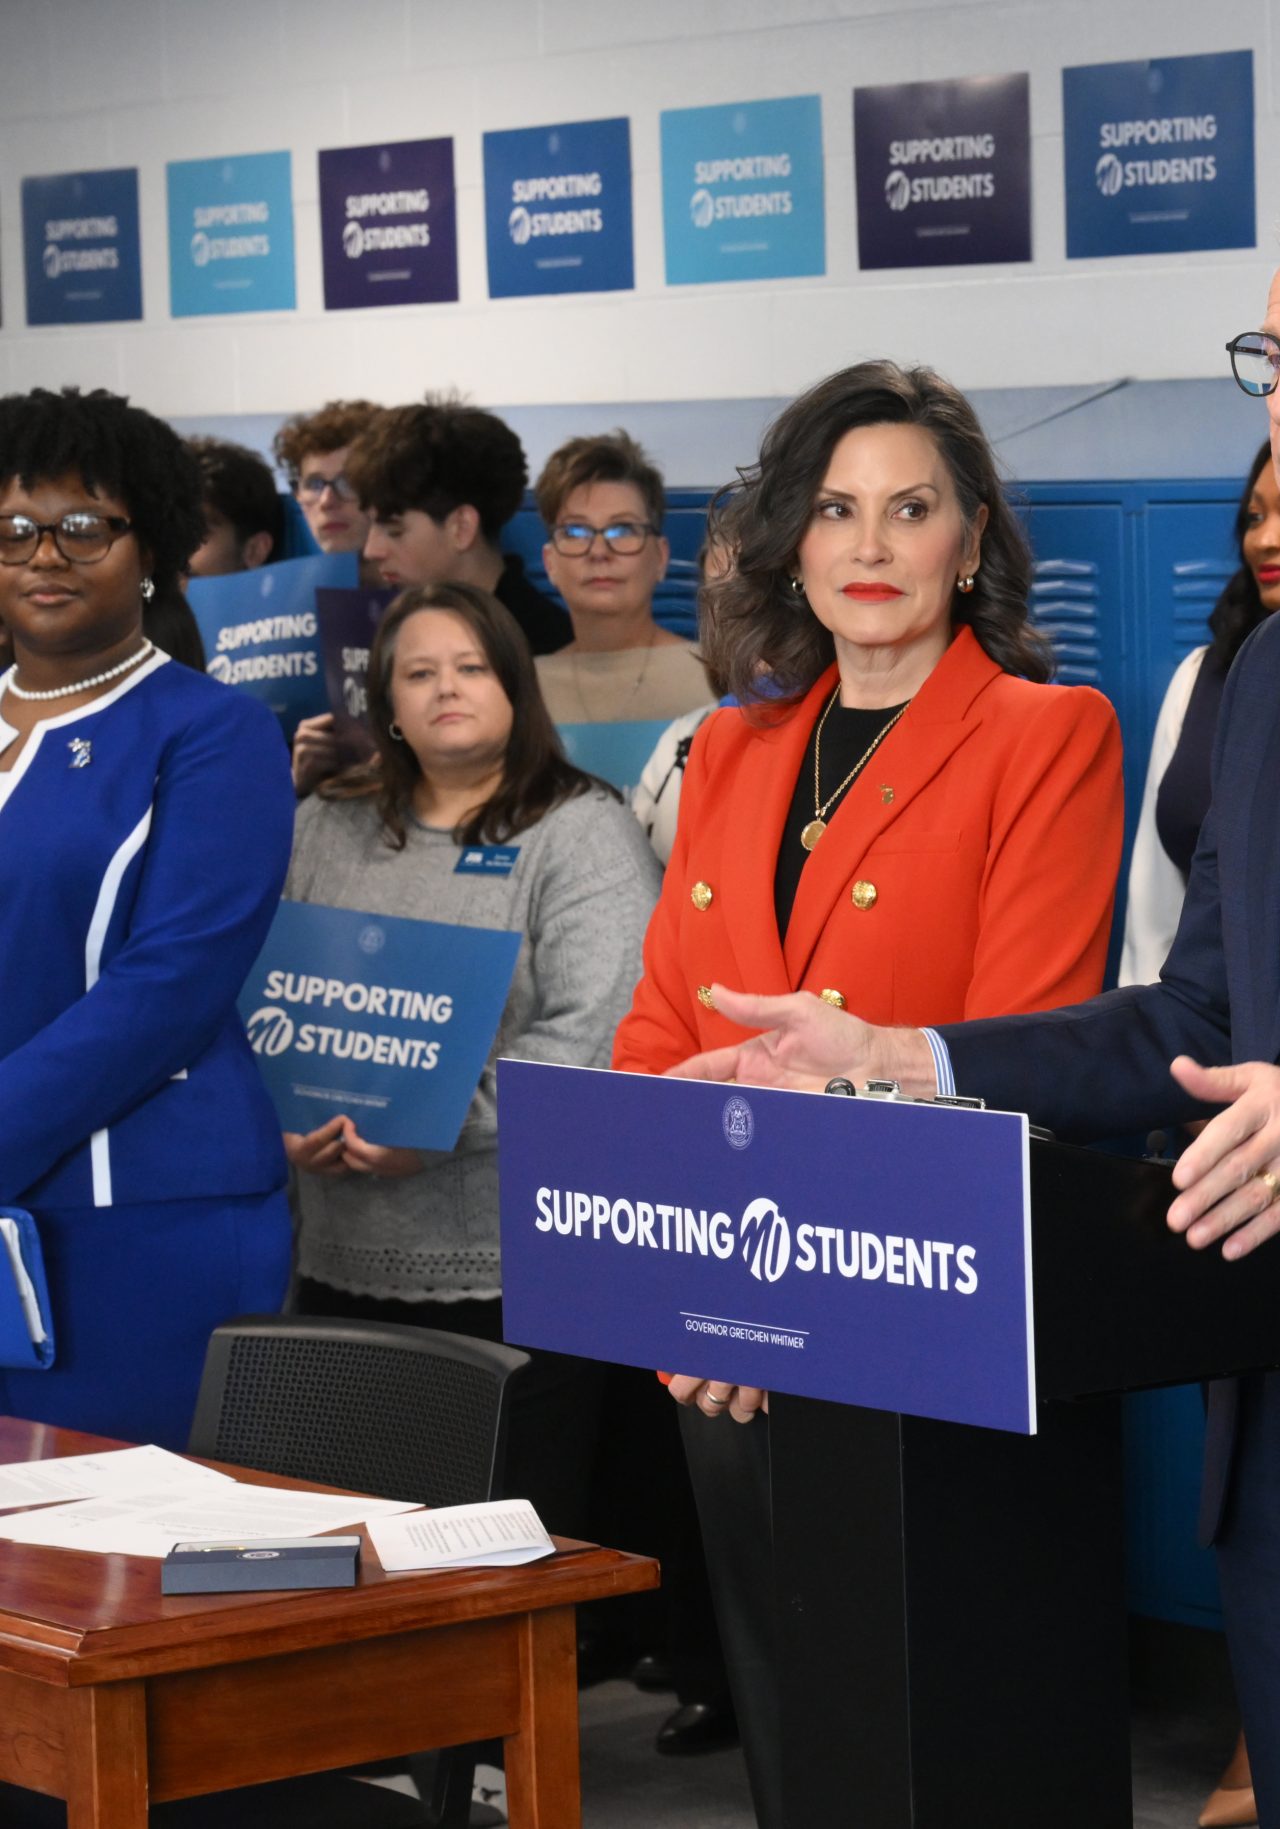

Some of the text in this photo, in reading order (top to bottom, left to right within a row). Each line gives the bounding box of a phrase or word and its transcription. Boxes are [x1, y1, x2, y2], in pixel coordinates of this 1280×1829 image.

[1100, 114, 1218, 148] SUPPORTING
[889, 133, 996, 165] SUPPORTING
[694, 153, 792, 185] SUPPORTING
[1124, 155, 1217, 187] STUDENTS
[511, 172, 602, 204] SUPPORTING
[909, 172, 995, 203] STUDENTS
[713, 191, 793, 220] STUDENTS
[529, 208, 603, 237] STUDENTS
[215, 612, 317, 652] SUPPORTING
[229, 651, 317, 685] STUDENTS
[263, 970, 453, 1024] SUPPORTING
[295, 1023, 441, 1070] STUDENTS
[535, 1186, 735, 1260] SUPPORTING
[794, 1223, 978, 1295] STUDENTS
[685, 1319, 804, 1349] GOVERNOR GRETCHEN WHITMER
